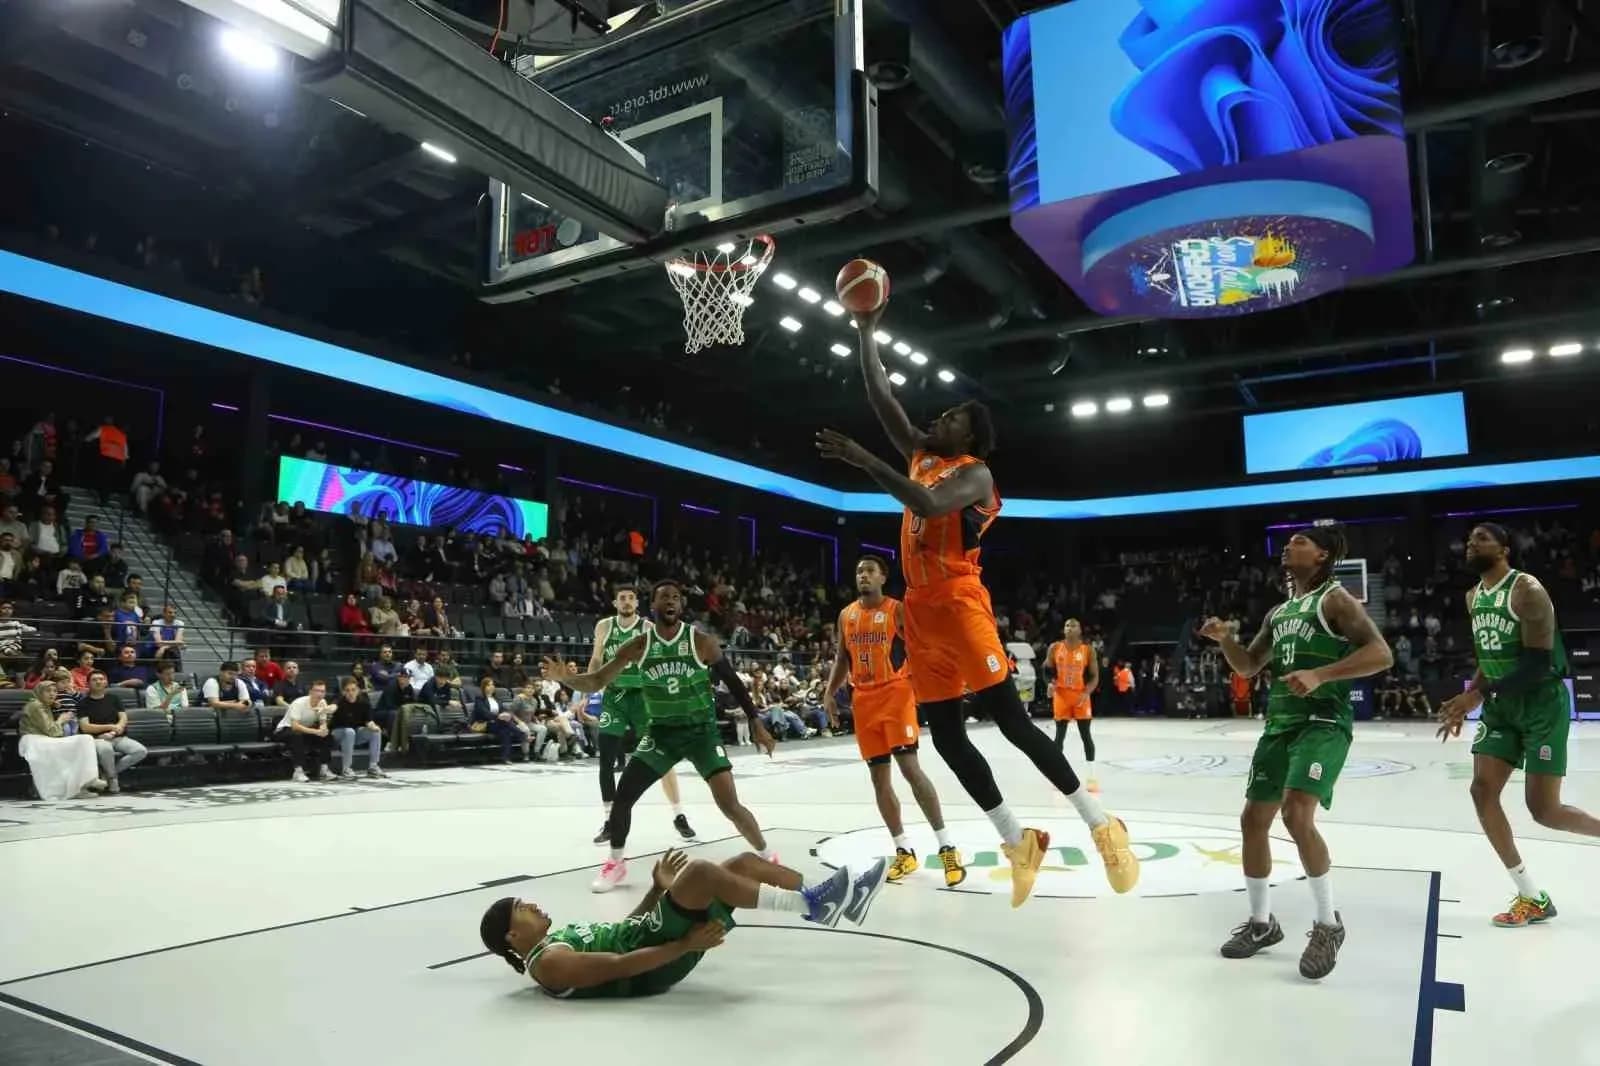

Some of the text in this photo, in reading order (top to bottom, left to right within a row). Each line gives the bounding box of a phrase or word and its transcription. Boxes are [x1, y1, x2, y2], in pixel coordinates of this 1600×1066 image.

[1479, 630, 1503, 650] 22
[1282, 642, 1295, 666] 31
[667, 677, 680, 694] 2
